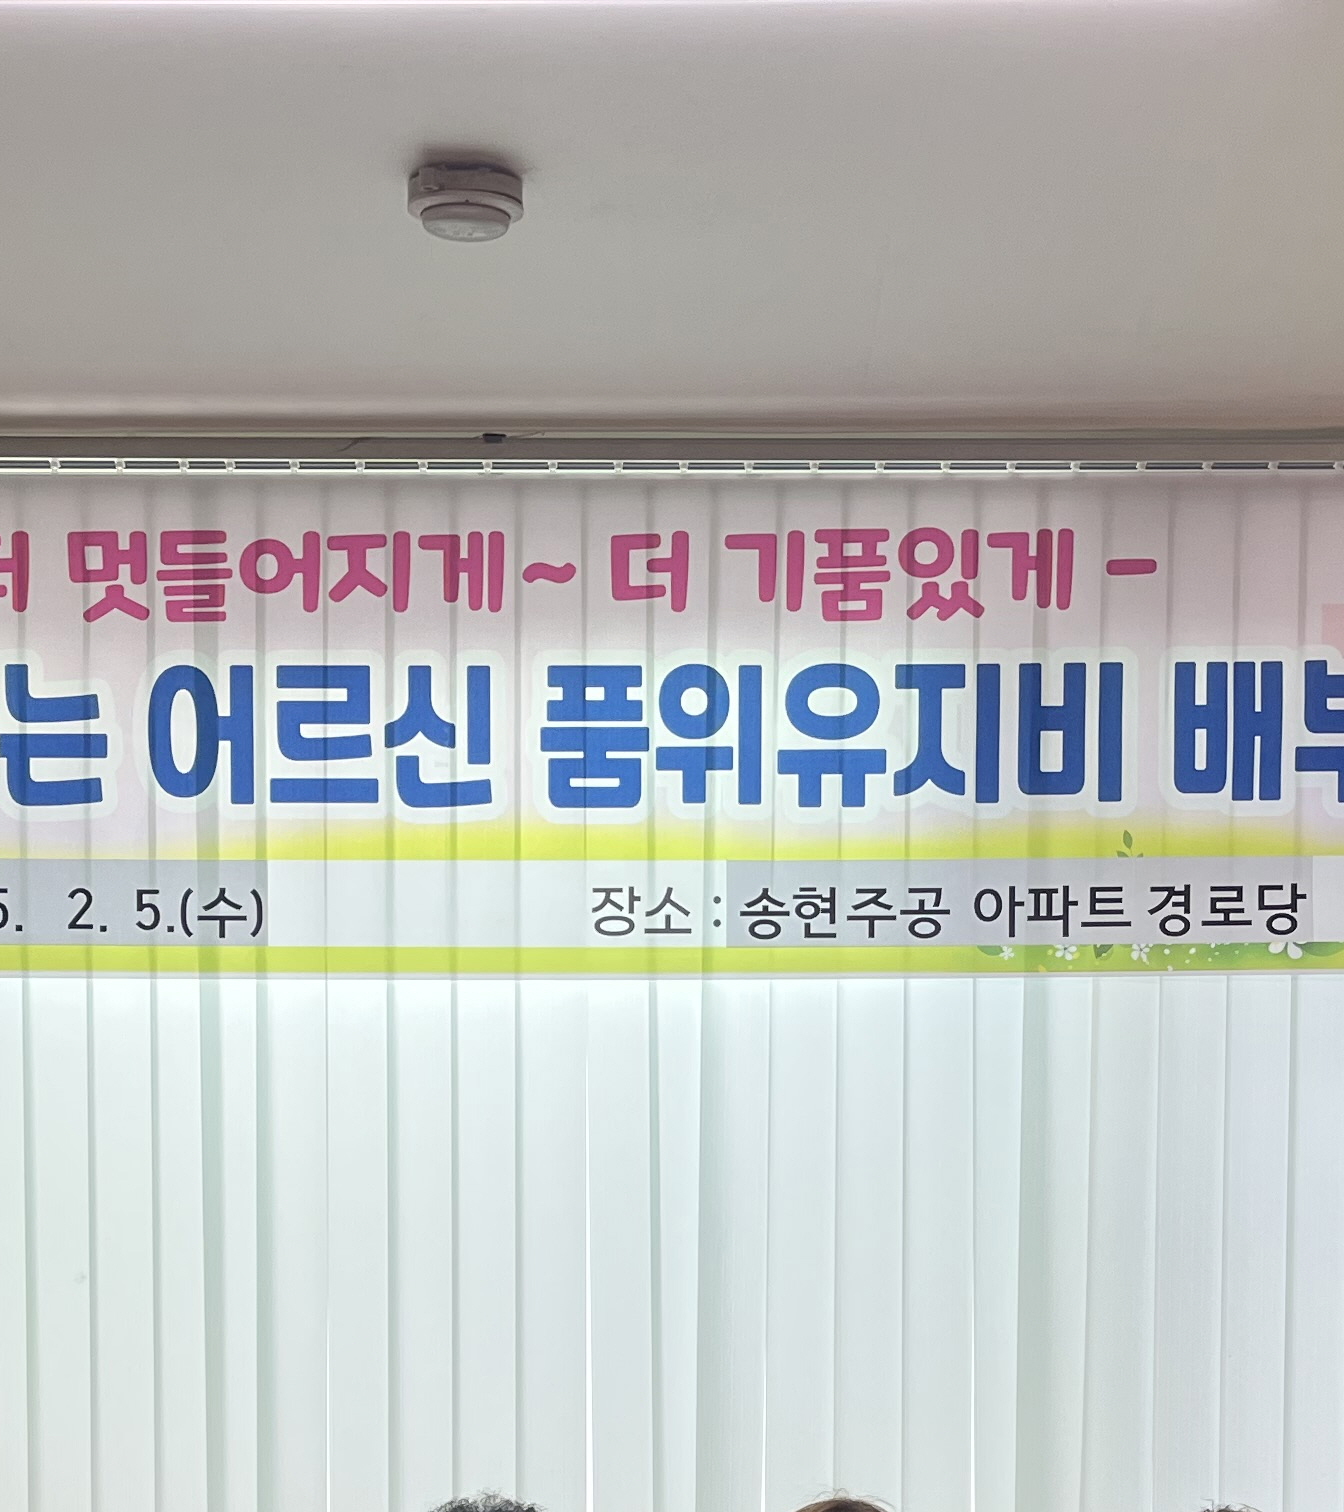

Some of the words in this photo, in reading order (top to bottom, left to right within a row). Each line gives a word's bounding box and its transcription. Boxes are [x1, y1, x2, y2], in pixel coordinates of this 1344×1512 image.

[612, 531, 691, 614] 더
[726, 528, 1076, 623] 기품있게
[150, 665, 492, 808] 어르신
[540, 663, 1124, 808] 품위유지비
[68, 888, 108, 934] 2.
[136, 887, 265, 940] 5.(수)
[591, 886, 693, 937] 장소
[739, 887, 953, 941] 송현주공
[973, 886, 1134, 939] 아파트
[1147, 884, 1308, 938] 경로당
